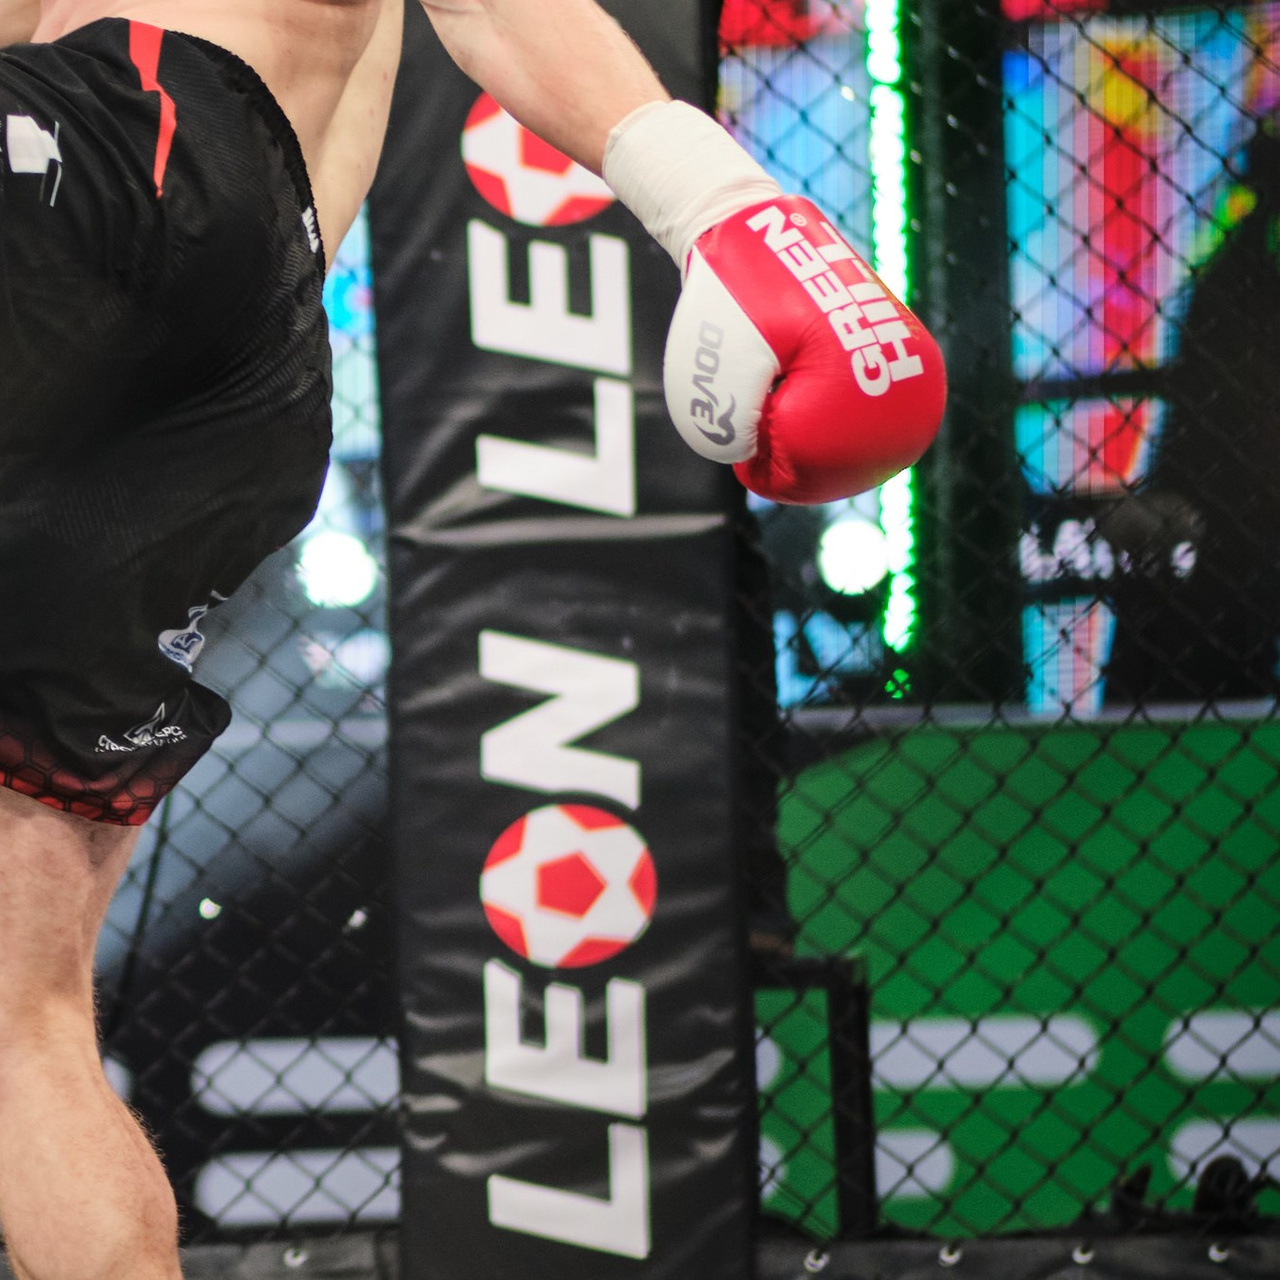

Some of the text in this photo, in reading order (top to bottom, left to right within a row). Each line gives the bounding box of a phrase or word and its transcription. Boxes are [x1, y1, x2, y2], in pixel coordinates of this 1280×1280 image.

[690, 319, 725, 426] DOVE
[815, 220, 925, 383] HILL
[478, 627, 658, 1261] LEON
